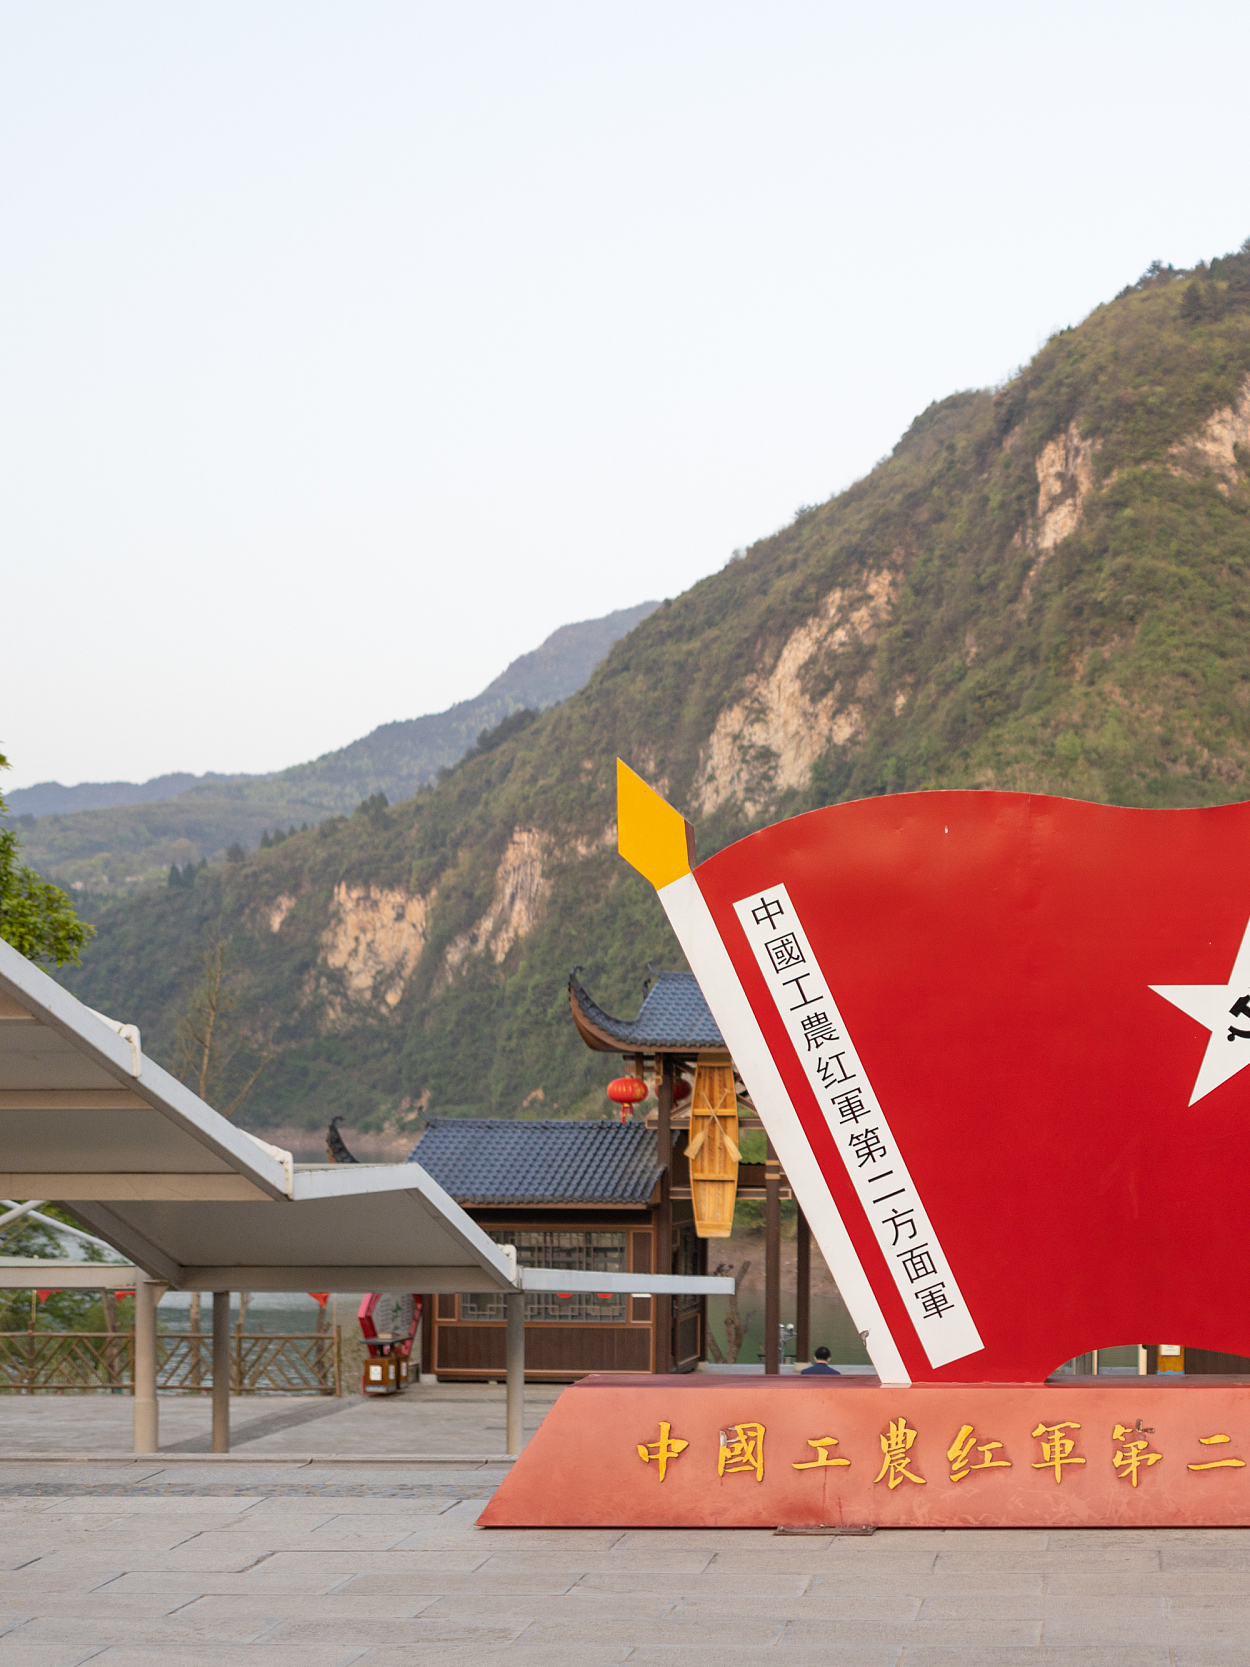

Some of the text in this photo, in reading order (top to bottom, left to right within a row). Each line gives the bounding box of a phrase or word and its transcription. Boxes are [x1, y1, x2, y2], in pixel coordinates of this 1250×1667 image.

[751, 897, 955, 1319] 中國工農红軍第二方面軍
